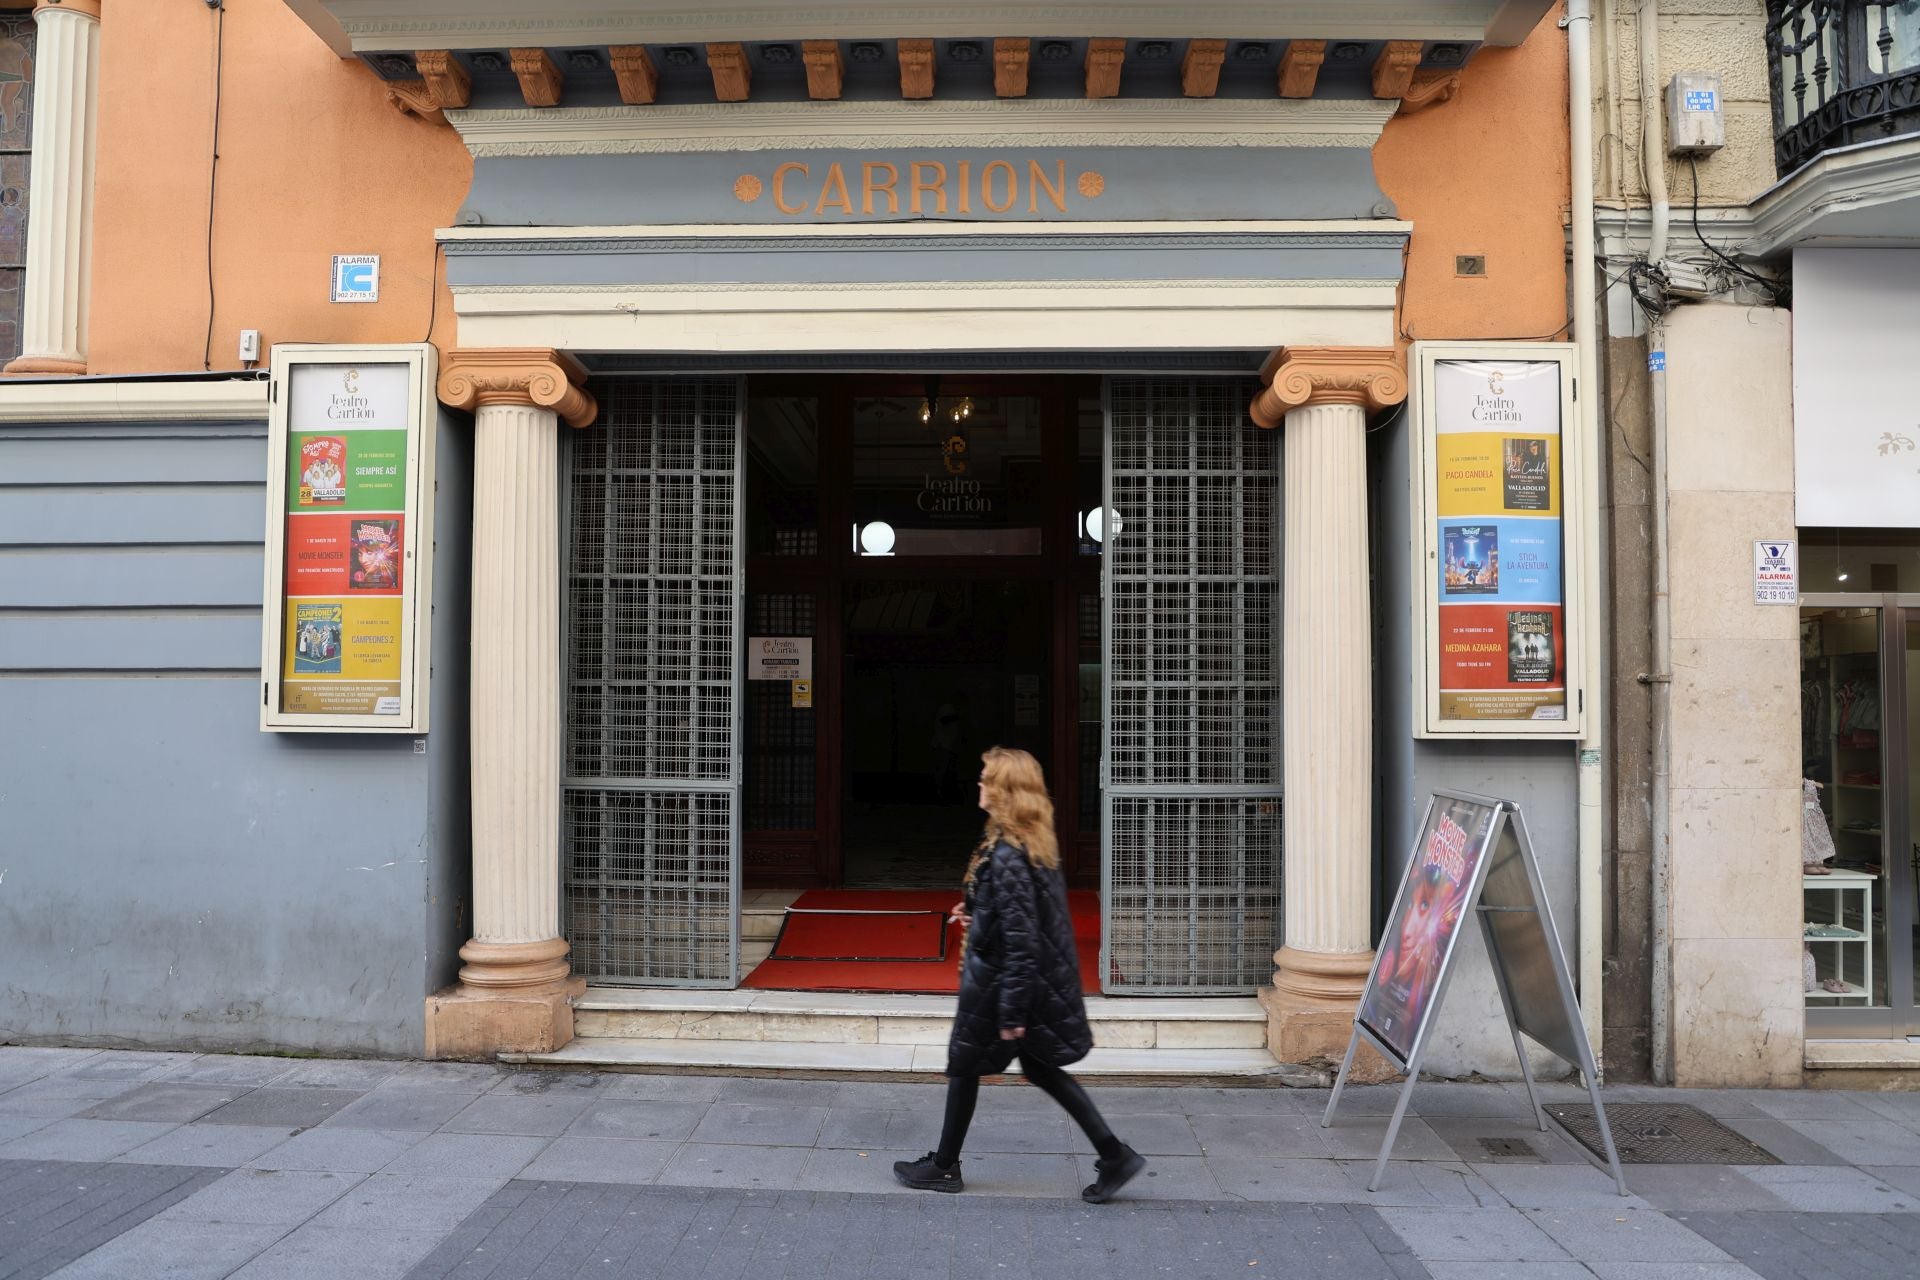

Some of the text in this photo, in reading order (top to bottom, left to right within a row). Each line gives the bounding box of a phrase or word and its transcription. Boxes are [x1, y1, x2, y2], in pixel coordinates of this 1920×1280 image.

[771, 159, 1068, 215] CARRION
[329, 393, 368, 408] Teatro
[1472, 394, 1515, 410] Teatro
[355, 464, 397, 475] SIEMPRE ASÍ
[1445, 470, 1494, 480] PACO CANDELA
[300, 490, 311, 498] 28
[298, 552, 344, 560] MOVIE MONSTER
[1507, 561, 1549, 570] LA AVENTURA
[1757, 591, 1794, 600] 902 19 10 10
[331, 607, 342, 622] 2
[351, 635, 394, 644] CAMPEONES 2
[1445, 643, 1502, 652] MEDINA AZAHARA
[1438, 811, 1467, 855] MOVIE
[1423, 828, 1466, 888] MONSTER
